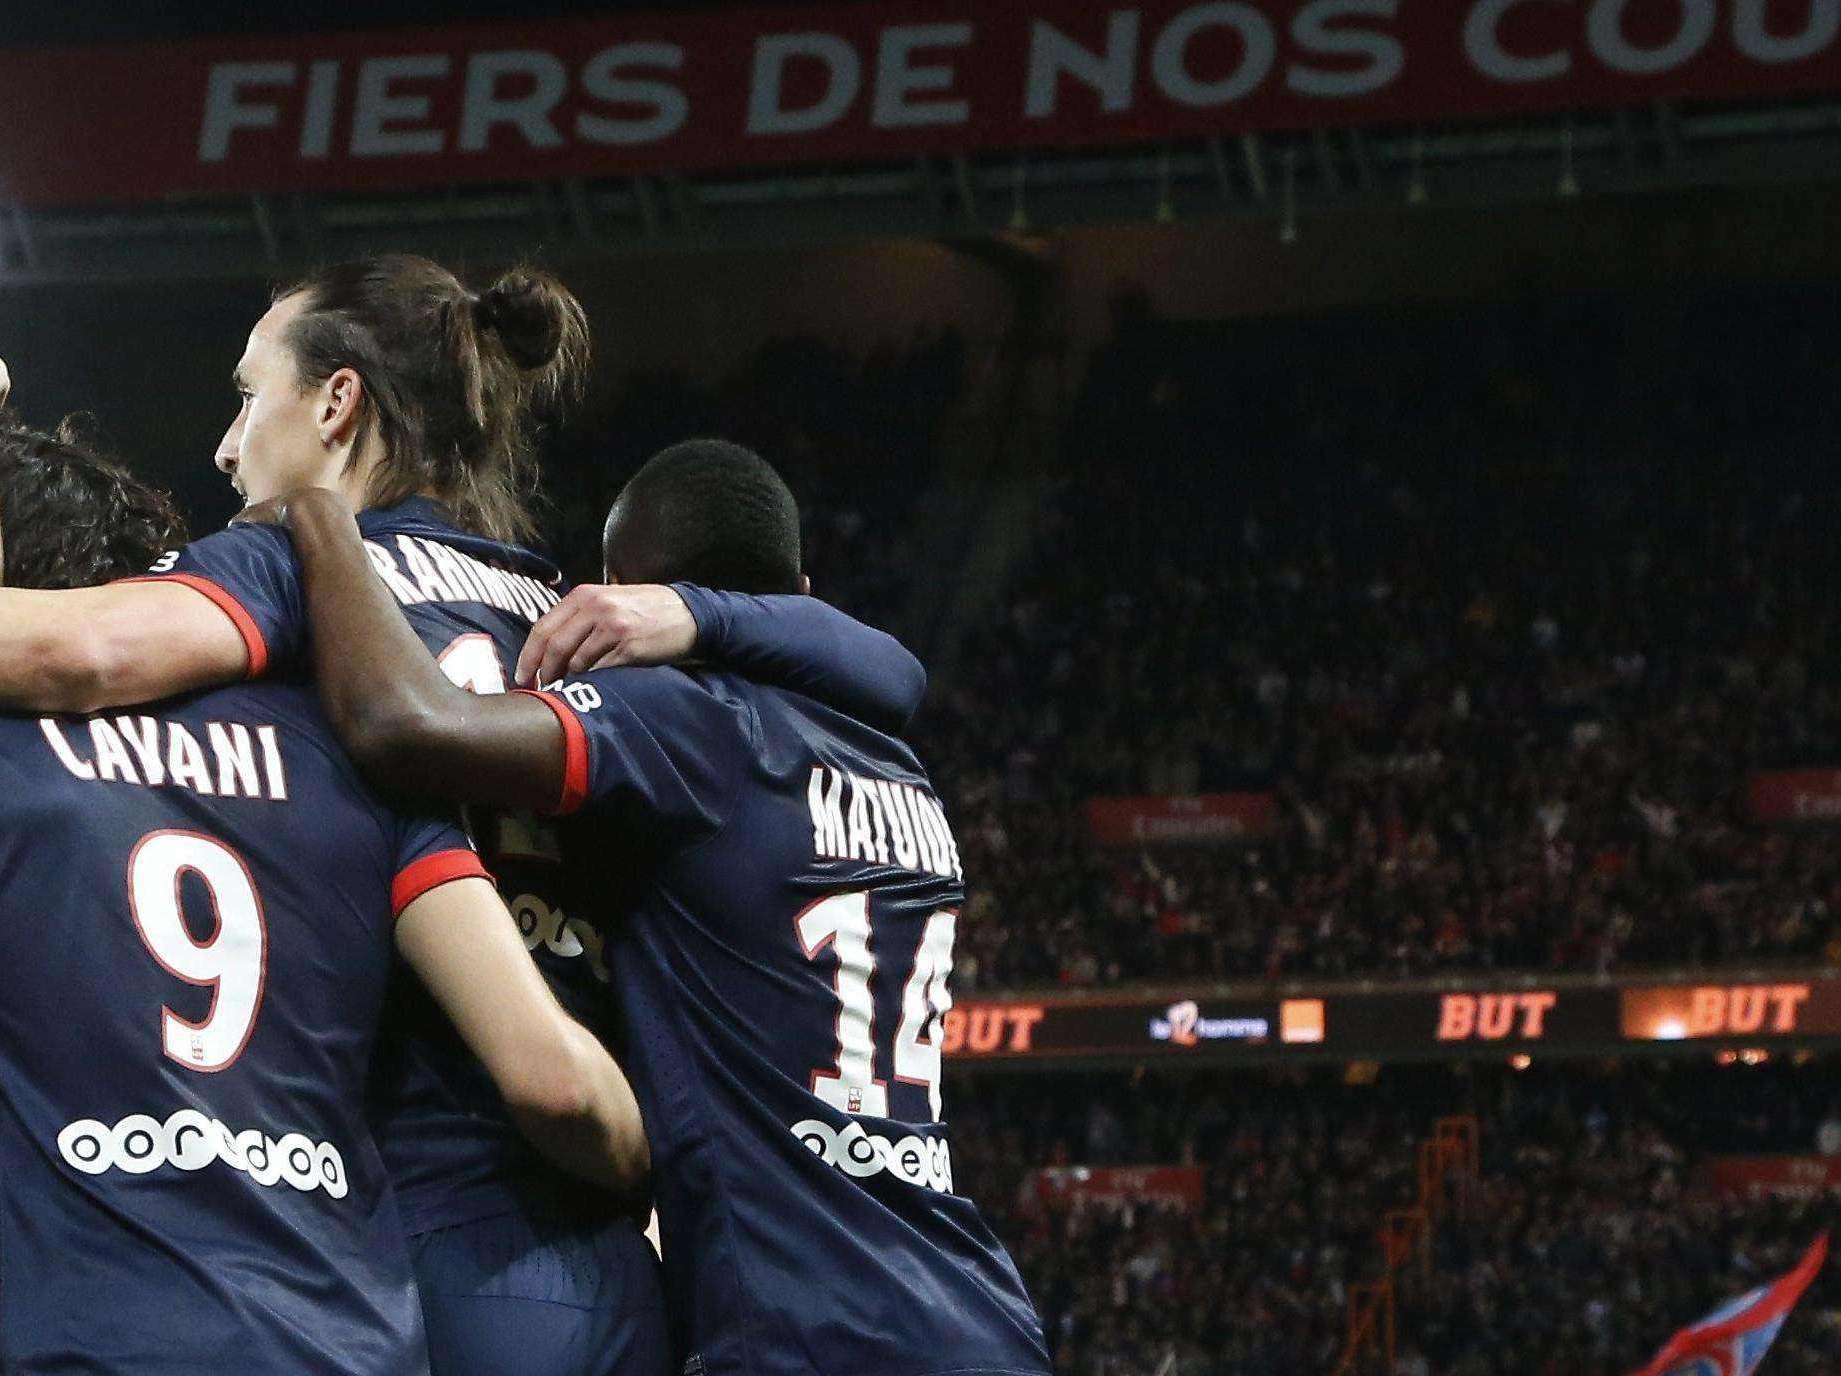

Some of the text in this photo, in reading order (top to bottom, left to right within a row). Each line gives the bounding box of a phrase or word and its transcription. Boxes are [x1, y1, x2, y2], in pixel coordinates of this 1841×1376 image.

[198, 41, 690, 162] FIERS
[745, 24, 972, 135] DE
[1024, 0, 1404, 117] NOS
[808, 766, 963, 884] MATUID
[127, 828, 268, 1073] 9
[793, 890, 958, 1122] 14
[942, 1005, 1045, 1052] BUT
[1437, 990, 1556, 1041] BUT
[1690, 984, 1811, 1036] BUT
